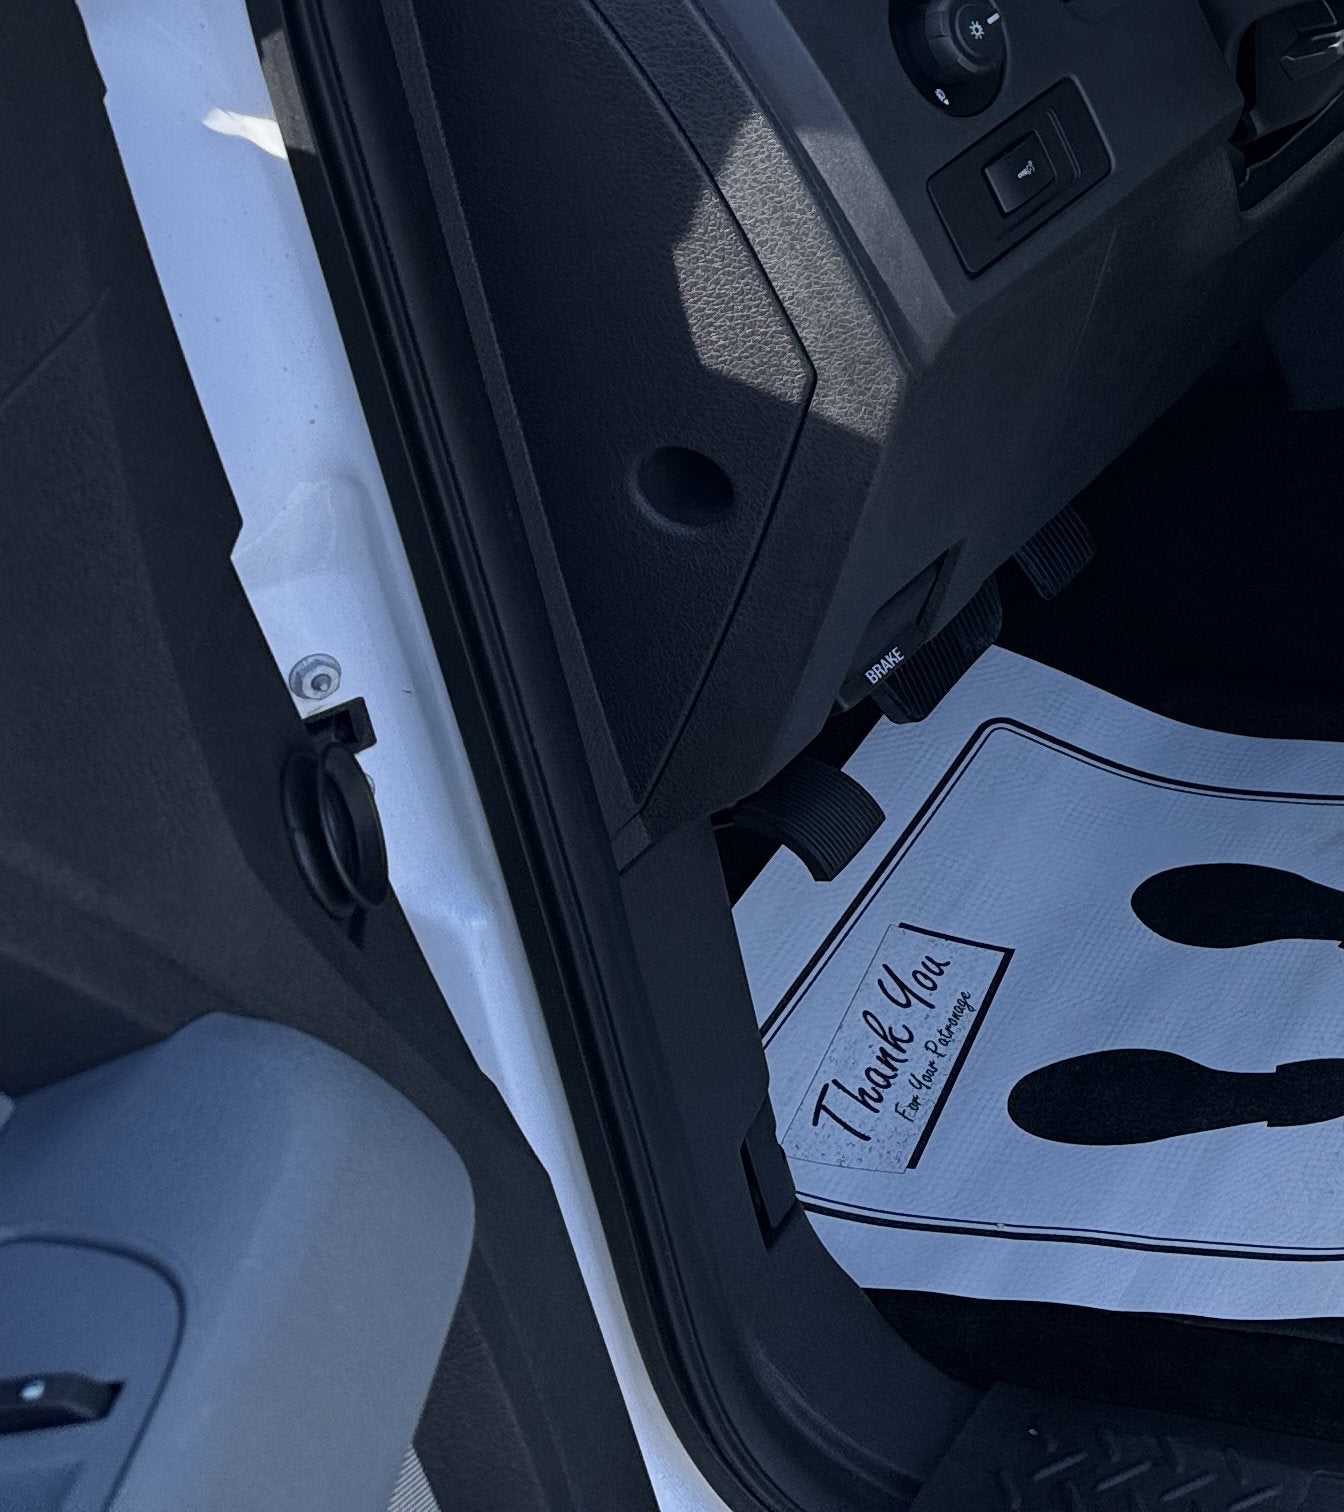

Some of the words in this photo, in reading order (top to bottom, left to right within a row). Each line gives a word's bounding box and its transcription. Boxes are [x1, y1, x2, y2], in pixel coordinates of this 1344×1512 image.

[864, 646, 905, 684] BRAKE
[811, 1009, 914, 1142] Thank
[877, 955, 951, 1009] You
[894, 1094, 922, 1123] For
[908, 1059, 938, 1090] Your
[924, 990, 977, 1058] Patronage
